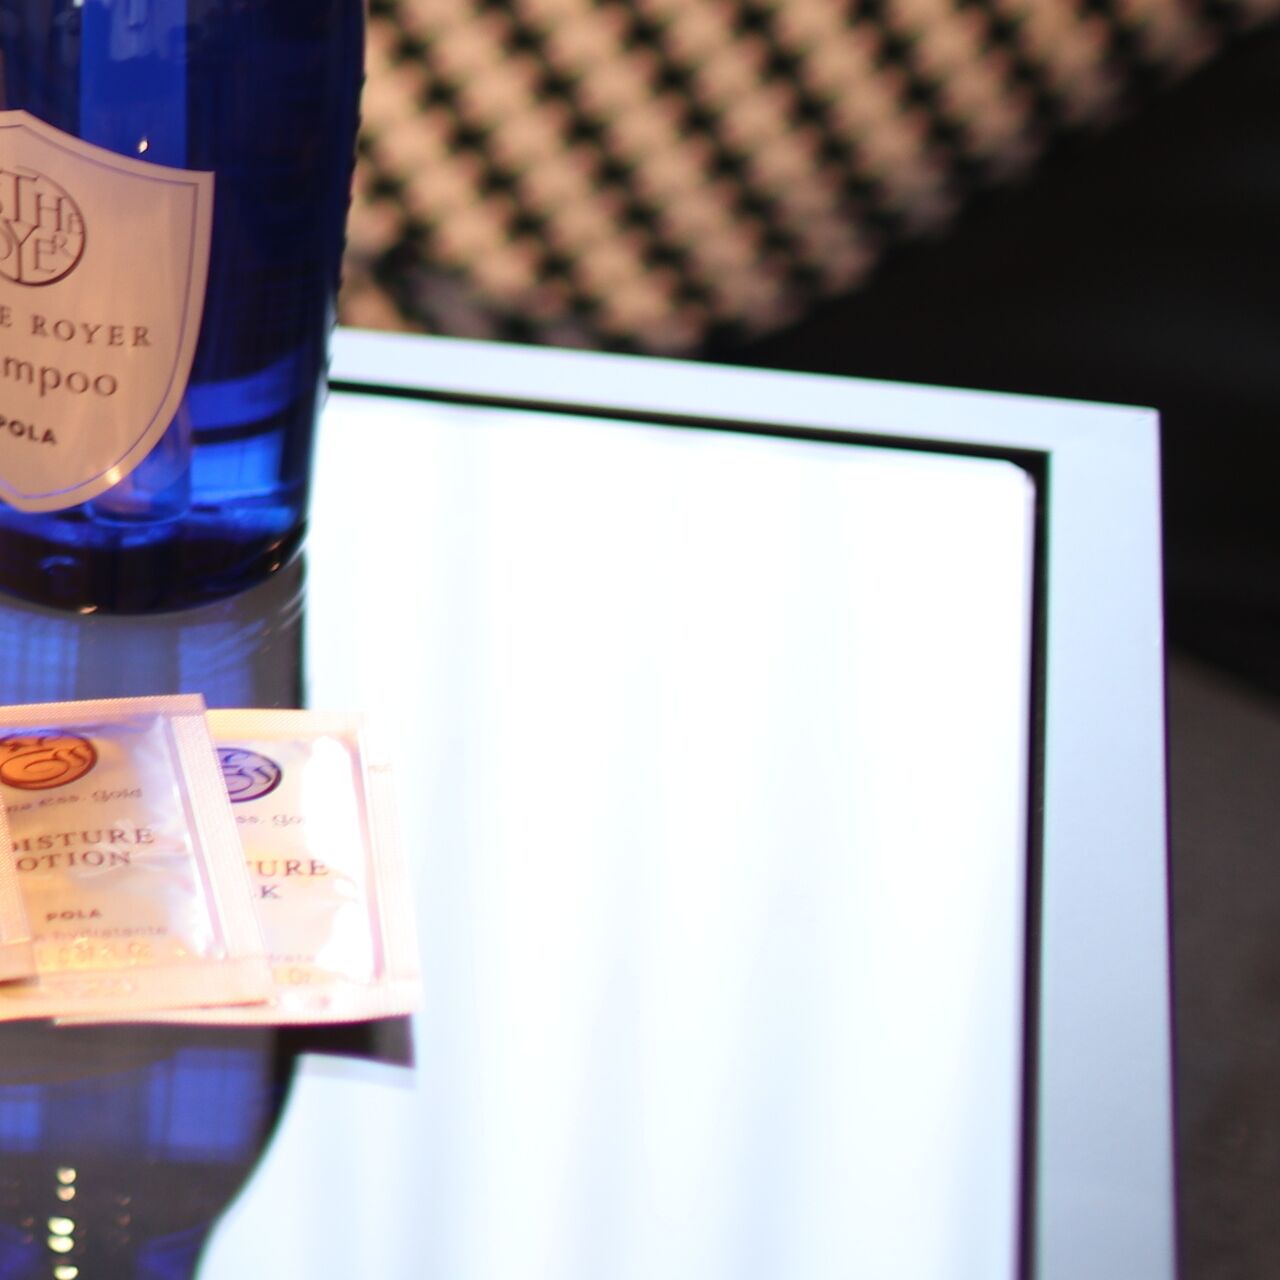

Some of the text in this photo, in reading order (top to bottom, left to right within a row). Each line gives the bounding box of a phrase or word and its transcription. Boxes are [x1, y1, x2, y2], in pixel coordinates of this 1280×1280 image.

[30, 314, 152, 348] ROYER
[16, 850, 132, 872] OTION
[245, 859, 328, 878] URE
[45, 909, 103, 923] POLA
